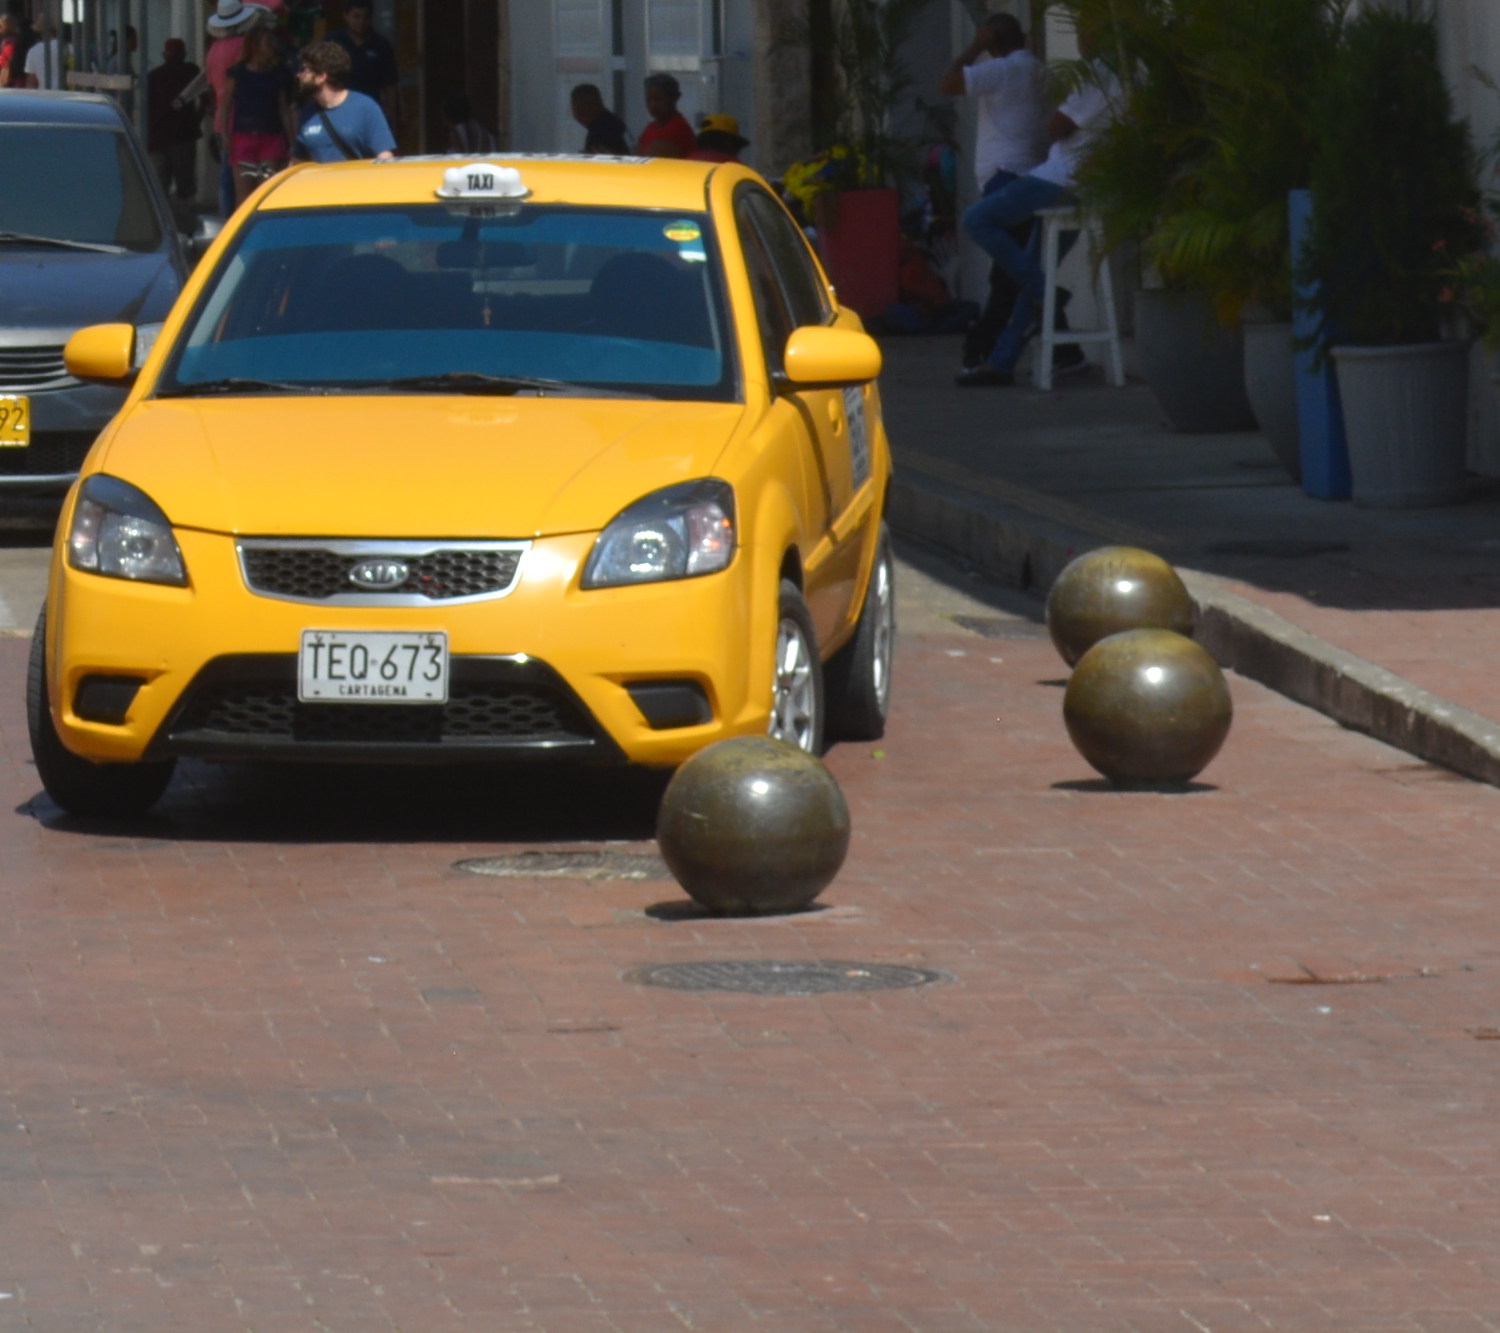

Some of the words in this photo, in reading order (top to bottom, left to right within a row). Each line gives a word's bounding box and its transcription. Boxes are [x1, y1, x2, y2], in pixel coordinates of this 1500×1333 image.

[467, 173, 494, 191] TAXI
[360, 564, 398, 581] KIA
[339, 684, 408, 697] CARTAGENA
